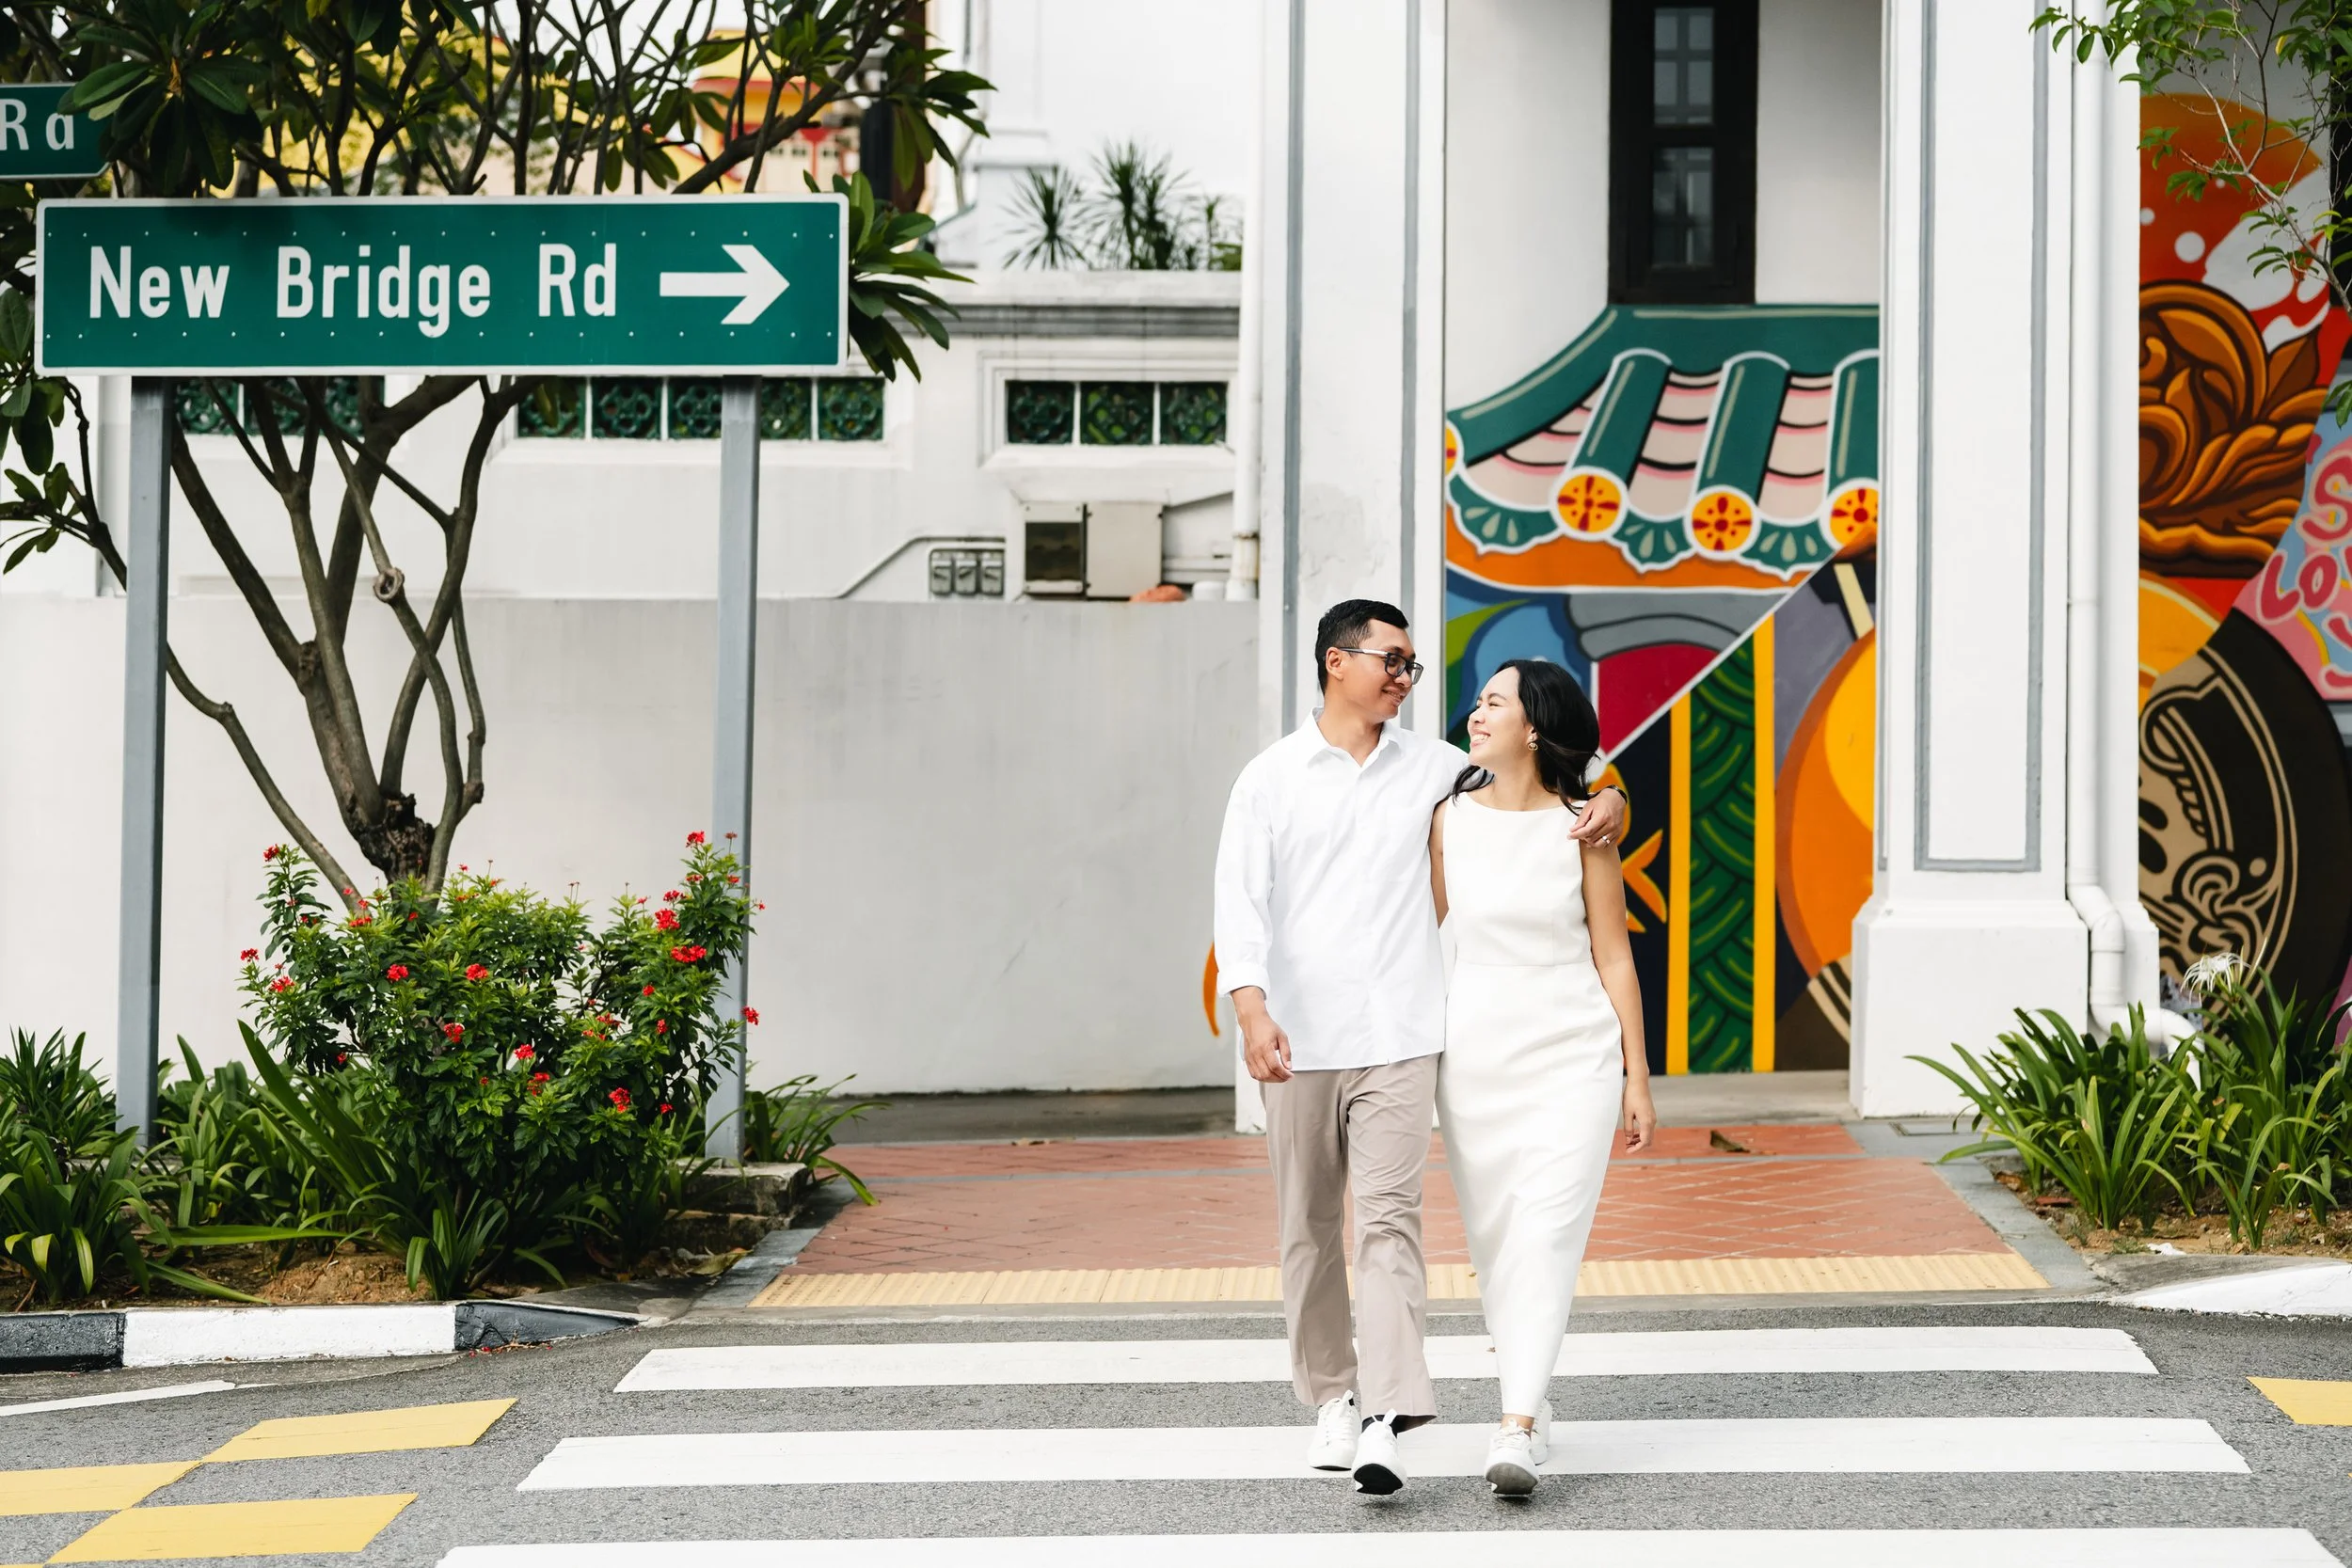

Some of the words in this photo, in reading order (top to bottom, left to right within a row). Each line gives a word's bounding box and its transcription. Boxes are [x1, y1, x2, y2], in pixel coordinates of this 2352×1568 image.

[89, 245, 230, 319] New
[277, 245, 491, 339] Bridge
[538, 243, 618, 318] Rd
